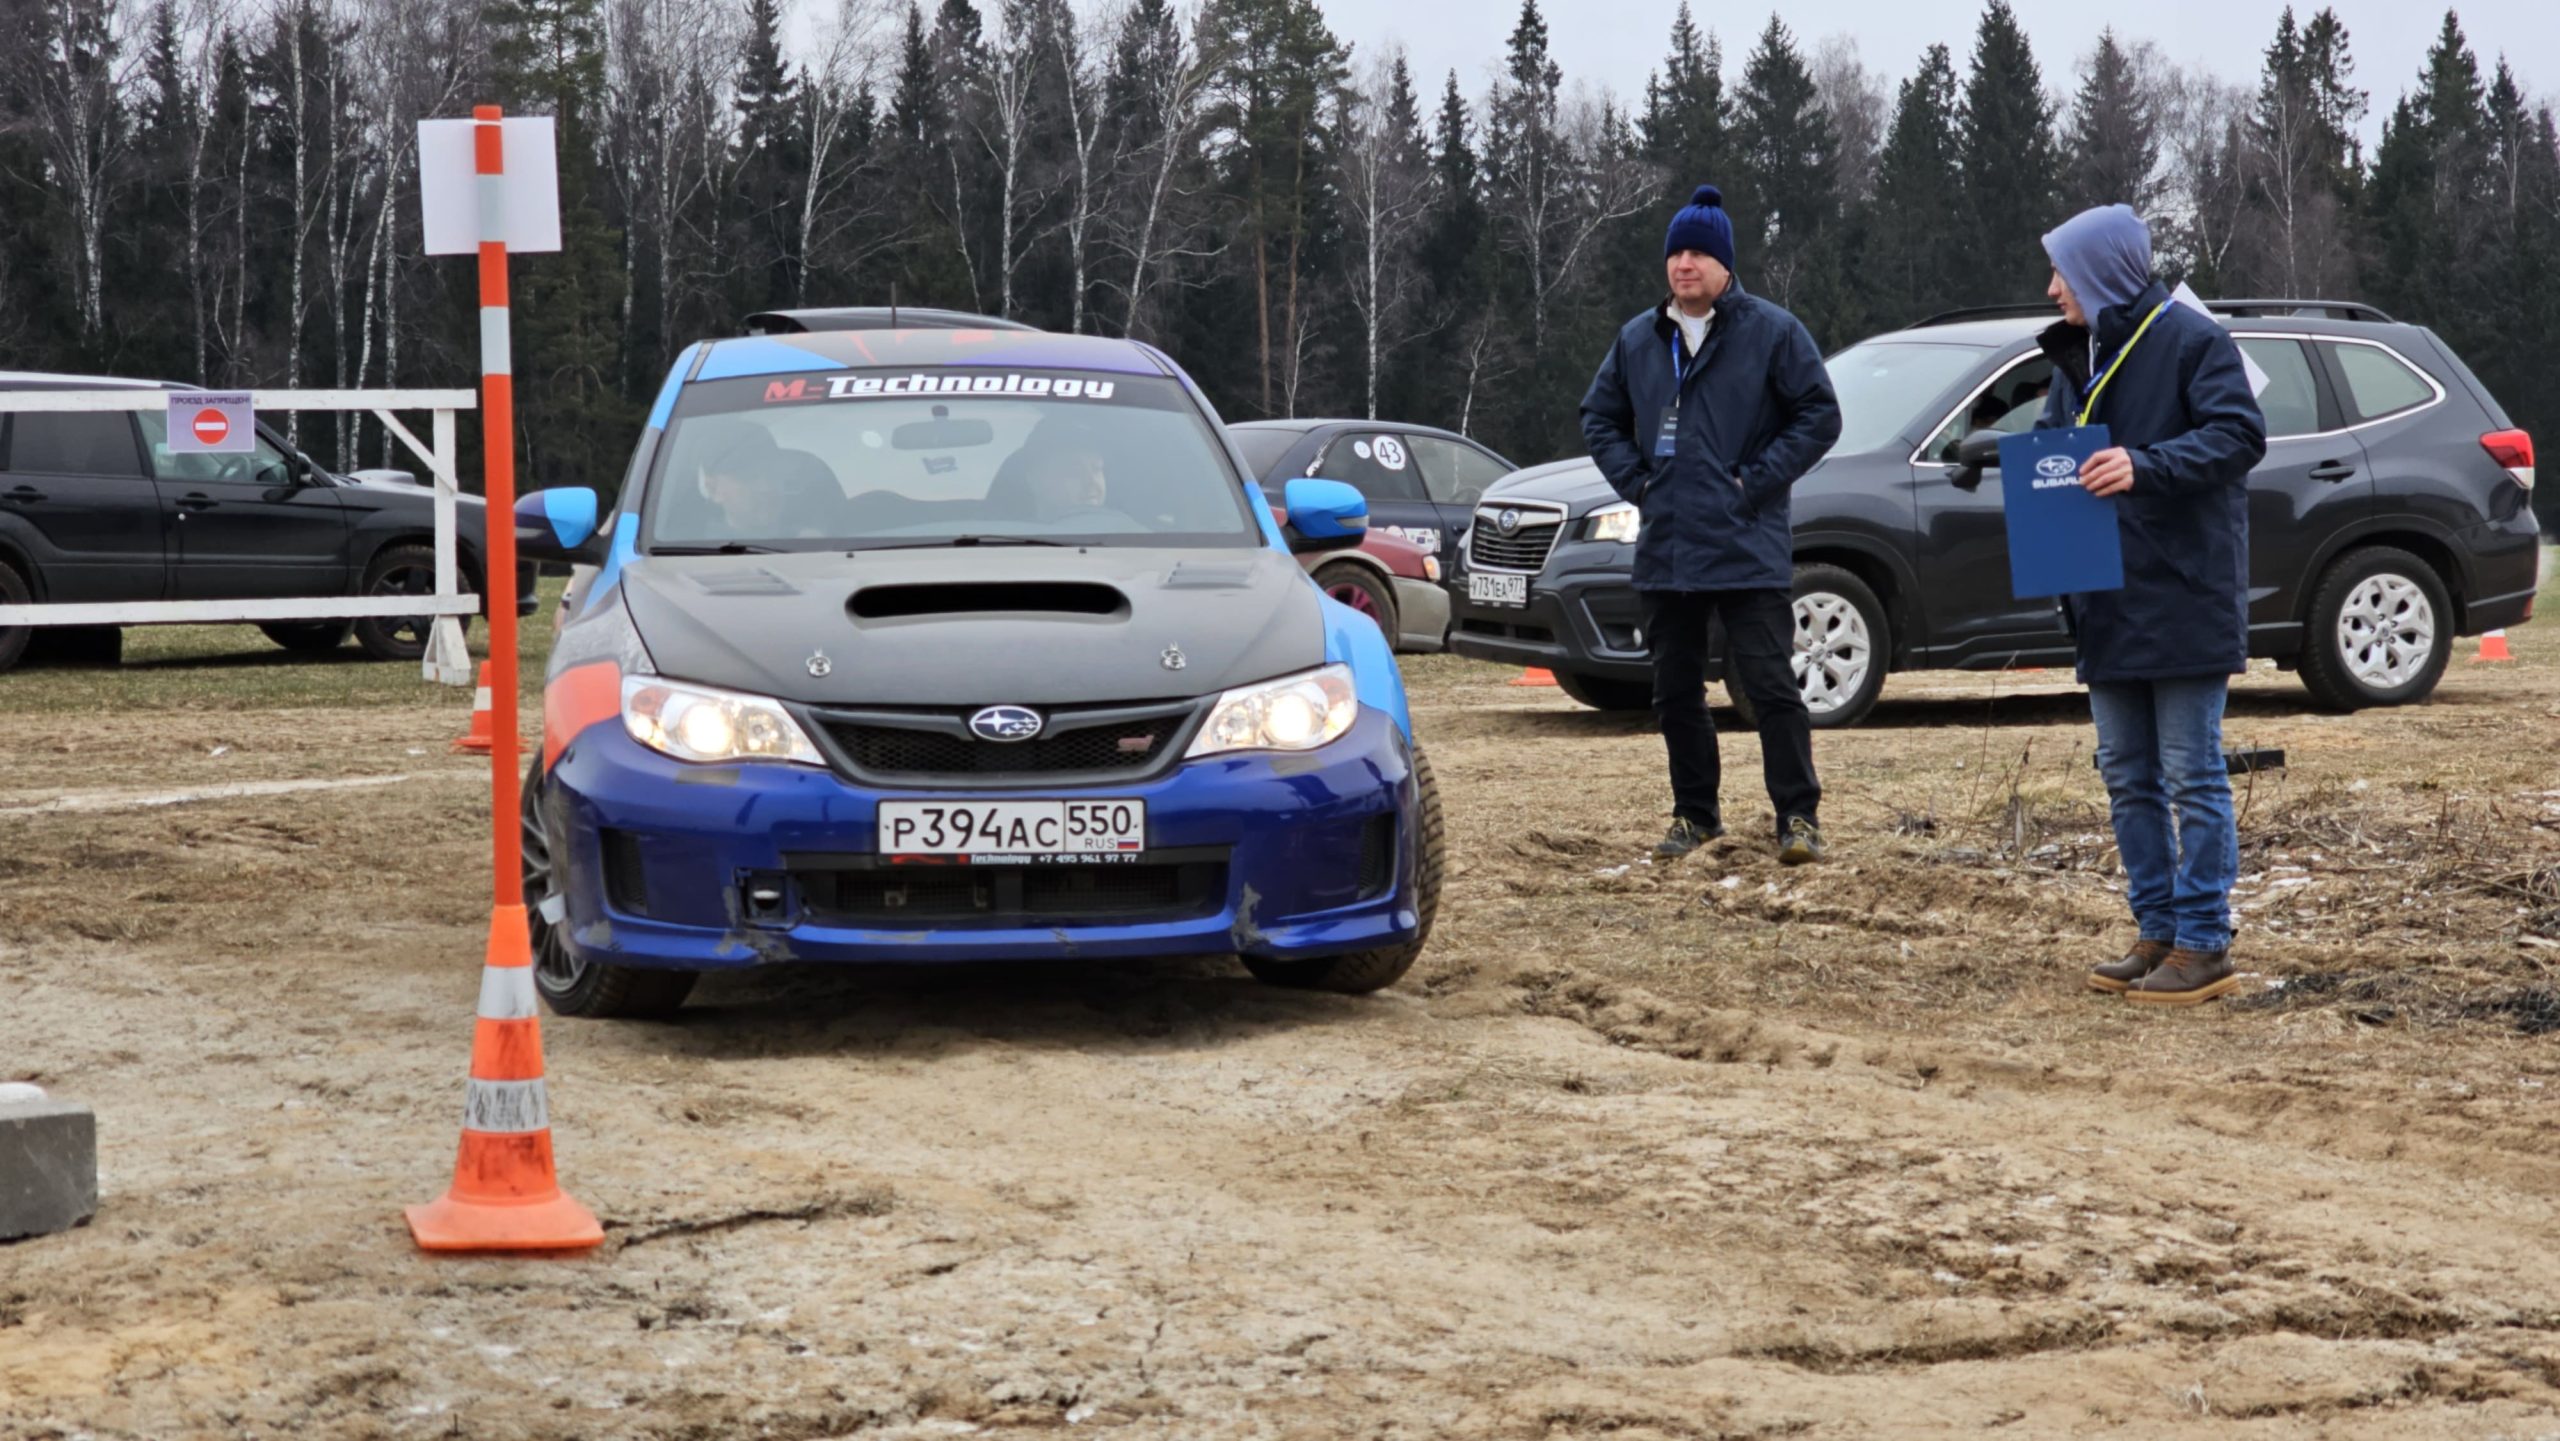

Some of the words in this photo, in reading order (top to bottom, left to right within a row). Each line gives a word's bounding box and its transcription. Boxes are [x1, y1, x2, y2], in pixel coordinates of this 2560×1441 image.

[764, 374, 1115, 402] M-Technology
[1379, 441, 1402, 464] 43
[893, 808, 1059, 848] Р394АС
[1068, 805, 1131, 836] 550
[1084, 837, 1116, 849] RUS
[1039, 854, 1053, 864] +7
[1056, 854, 1078, 864] 495
[1080, 854, 1101, 864] 961
[1104, 854, 1119, 864] 97
[1122, 854, 1138, 864] 77
